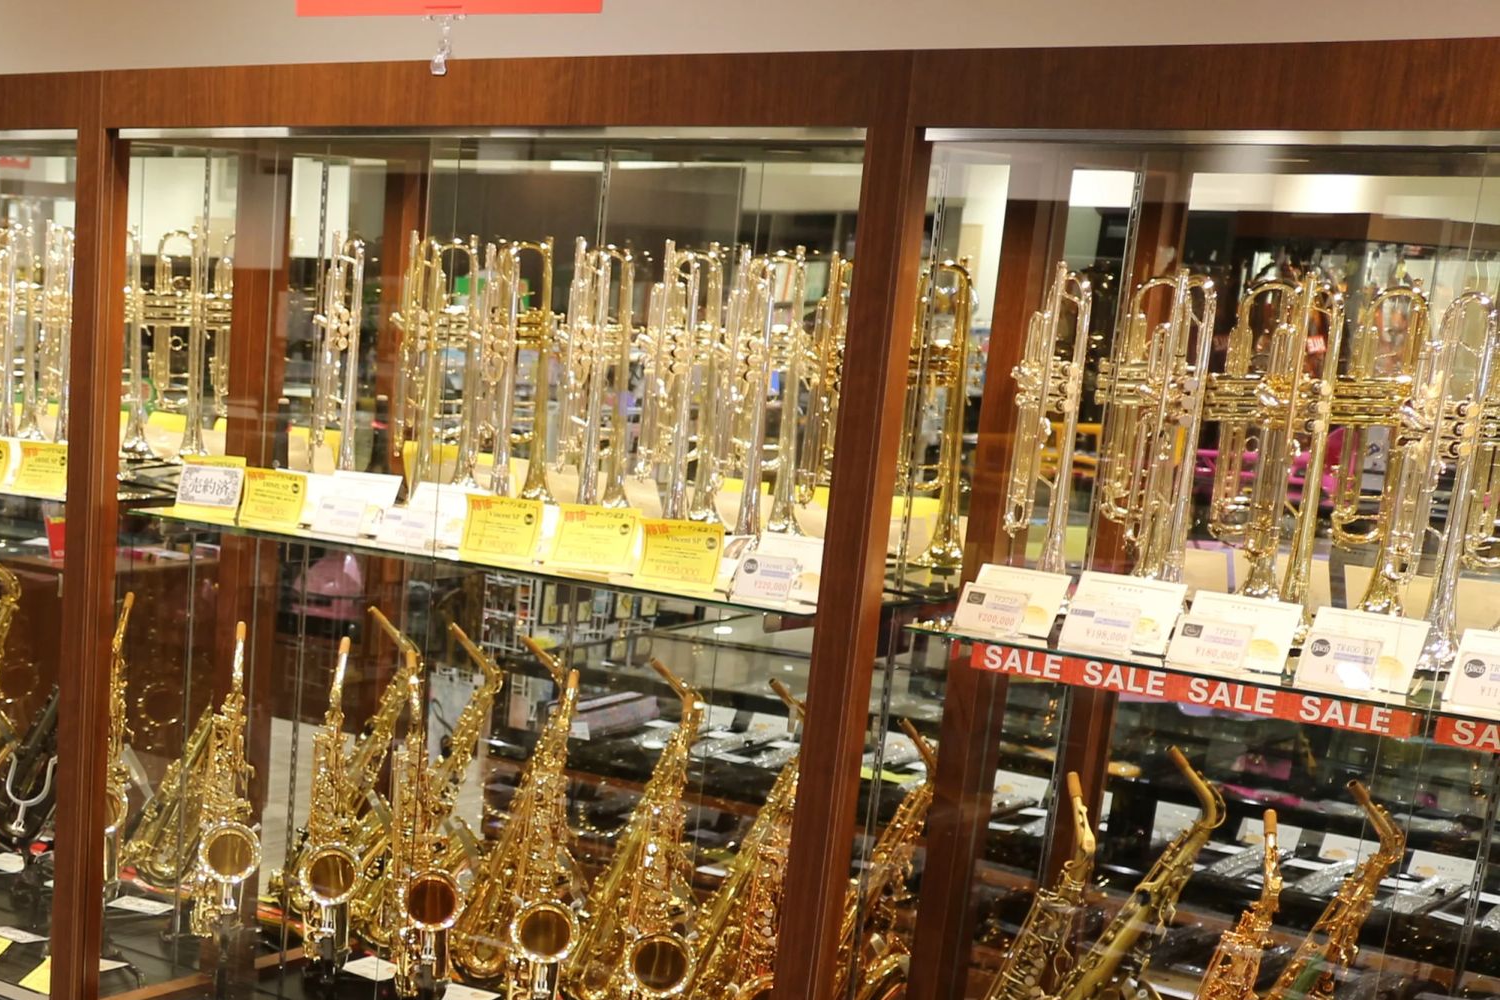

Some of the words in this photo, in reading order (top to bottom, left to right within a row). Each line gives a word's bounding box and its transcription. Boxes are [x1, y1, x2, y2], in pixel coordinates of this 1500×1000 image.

[983, 645, 1063, 679] SALE
[1083, 661, 1166, 696] SALE
[1188, 679, 1276, 714] SALE
[1300, 696, 1393, 733] SALE
